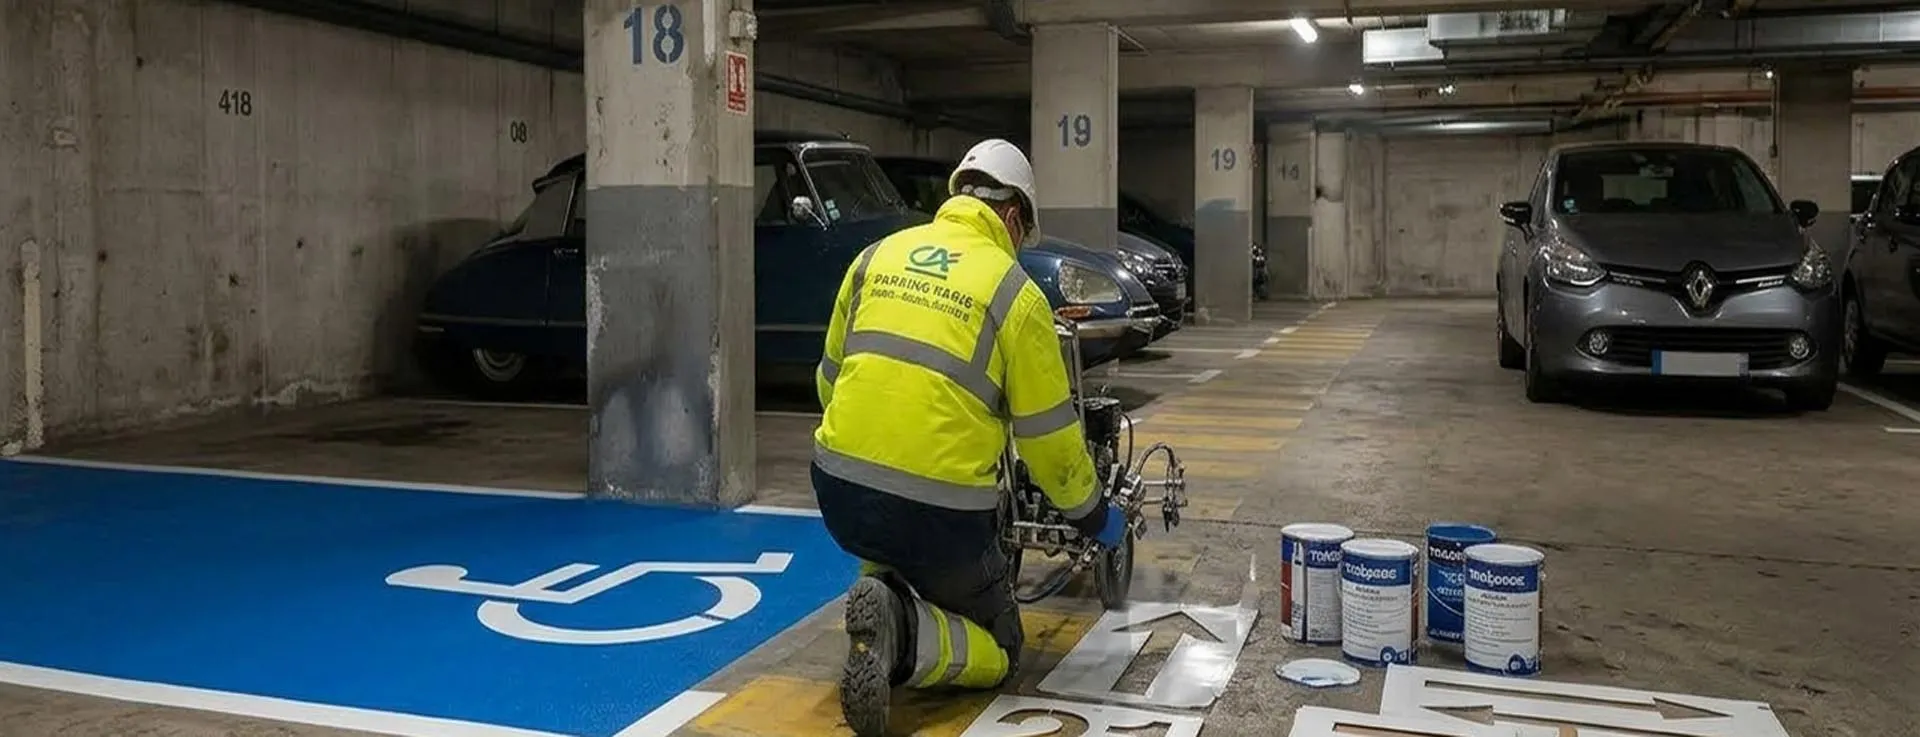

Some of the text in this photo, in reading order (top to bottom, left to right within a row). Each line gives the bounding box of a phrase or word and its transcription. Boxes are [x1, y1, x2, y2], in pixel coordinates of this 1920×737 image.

[624, 4, 684, 64] 18
[219, 89, 252, 116] 418
[1057, 114, 1091, 147] 19
[1211, 148, 1236, 171] 19
